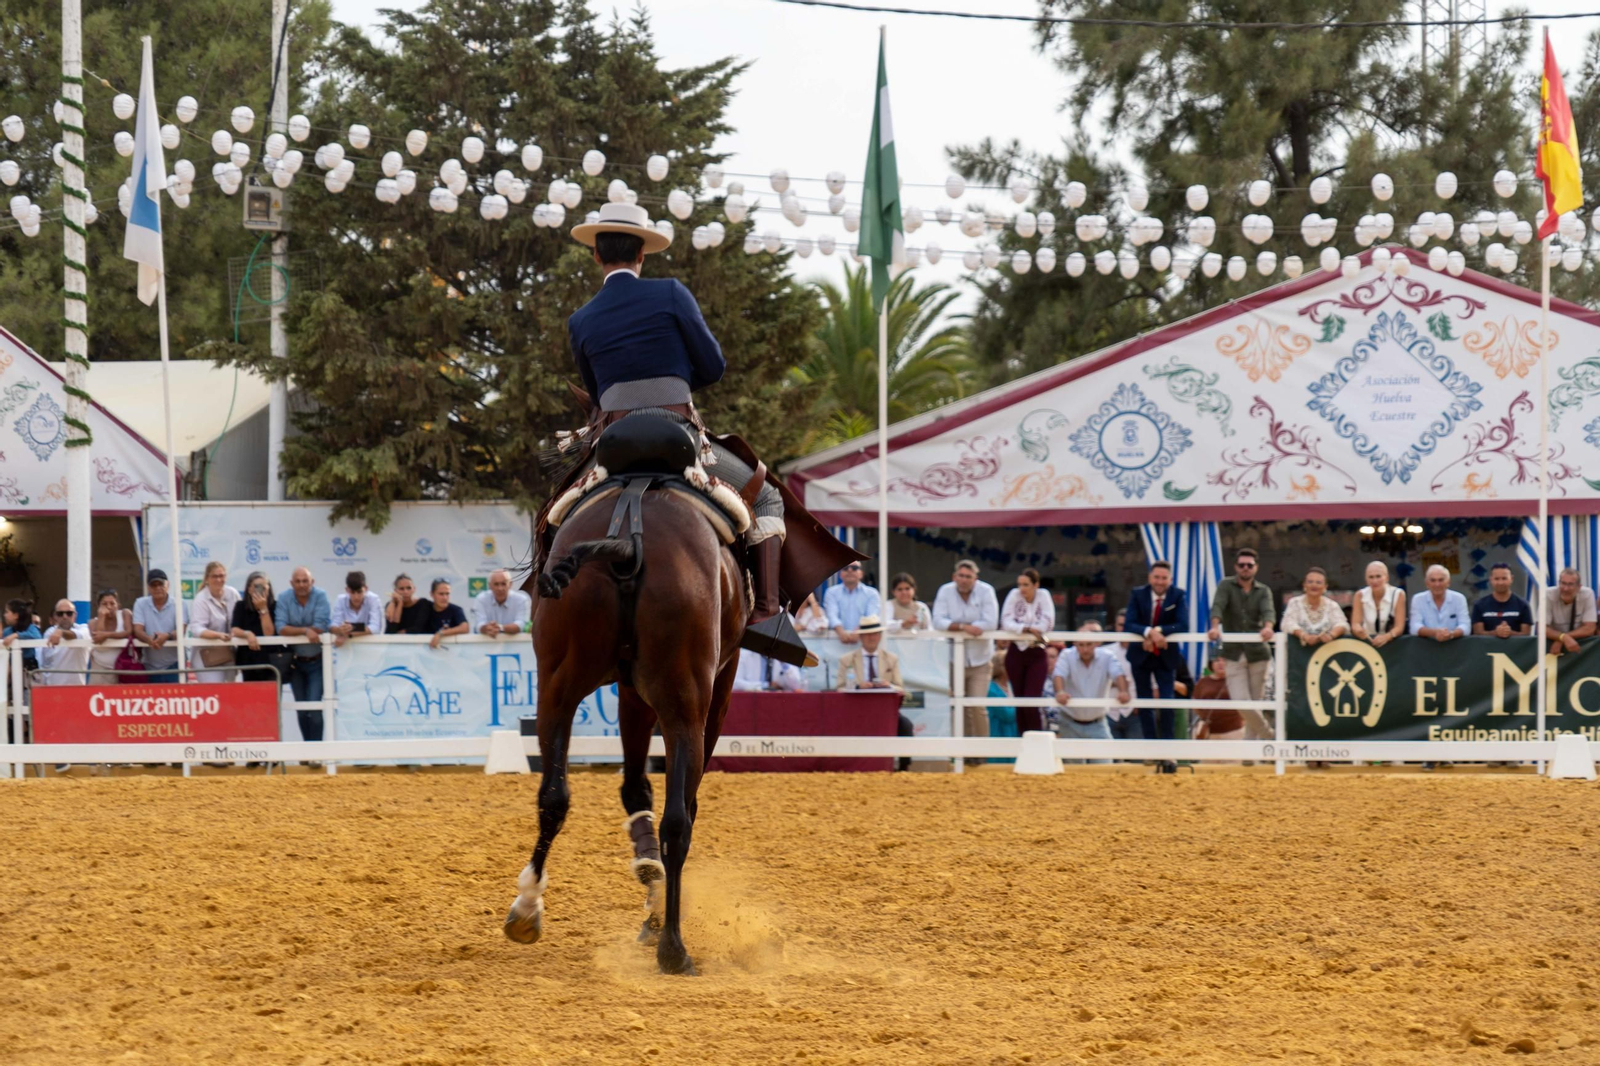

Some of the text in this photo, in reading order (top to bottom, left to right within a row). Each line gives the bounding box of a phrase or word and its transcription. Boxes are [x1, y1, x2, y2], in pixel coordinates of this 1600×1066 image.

[1361, 374, 1420, 388] Asociación
[1372, 391, 1412, 403] Huelva
[1370, 410, 1417, 422] Ecuestre
[1411, 676, 1469, 716] EL
[89, 692, 220, 719] Cruzcampo
[117, 723, 194, 738] ESPECIAL
[201, 750, 210, 759] EL
